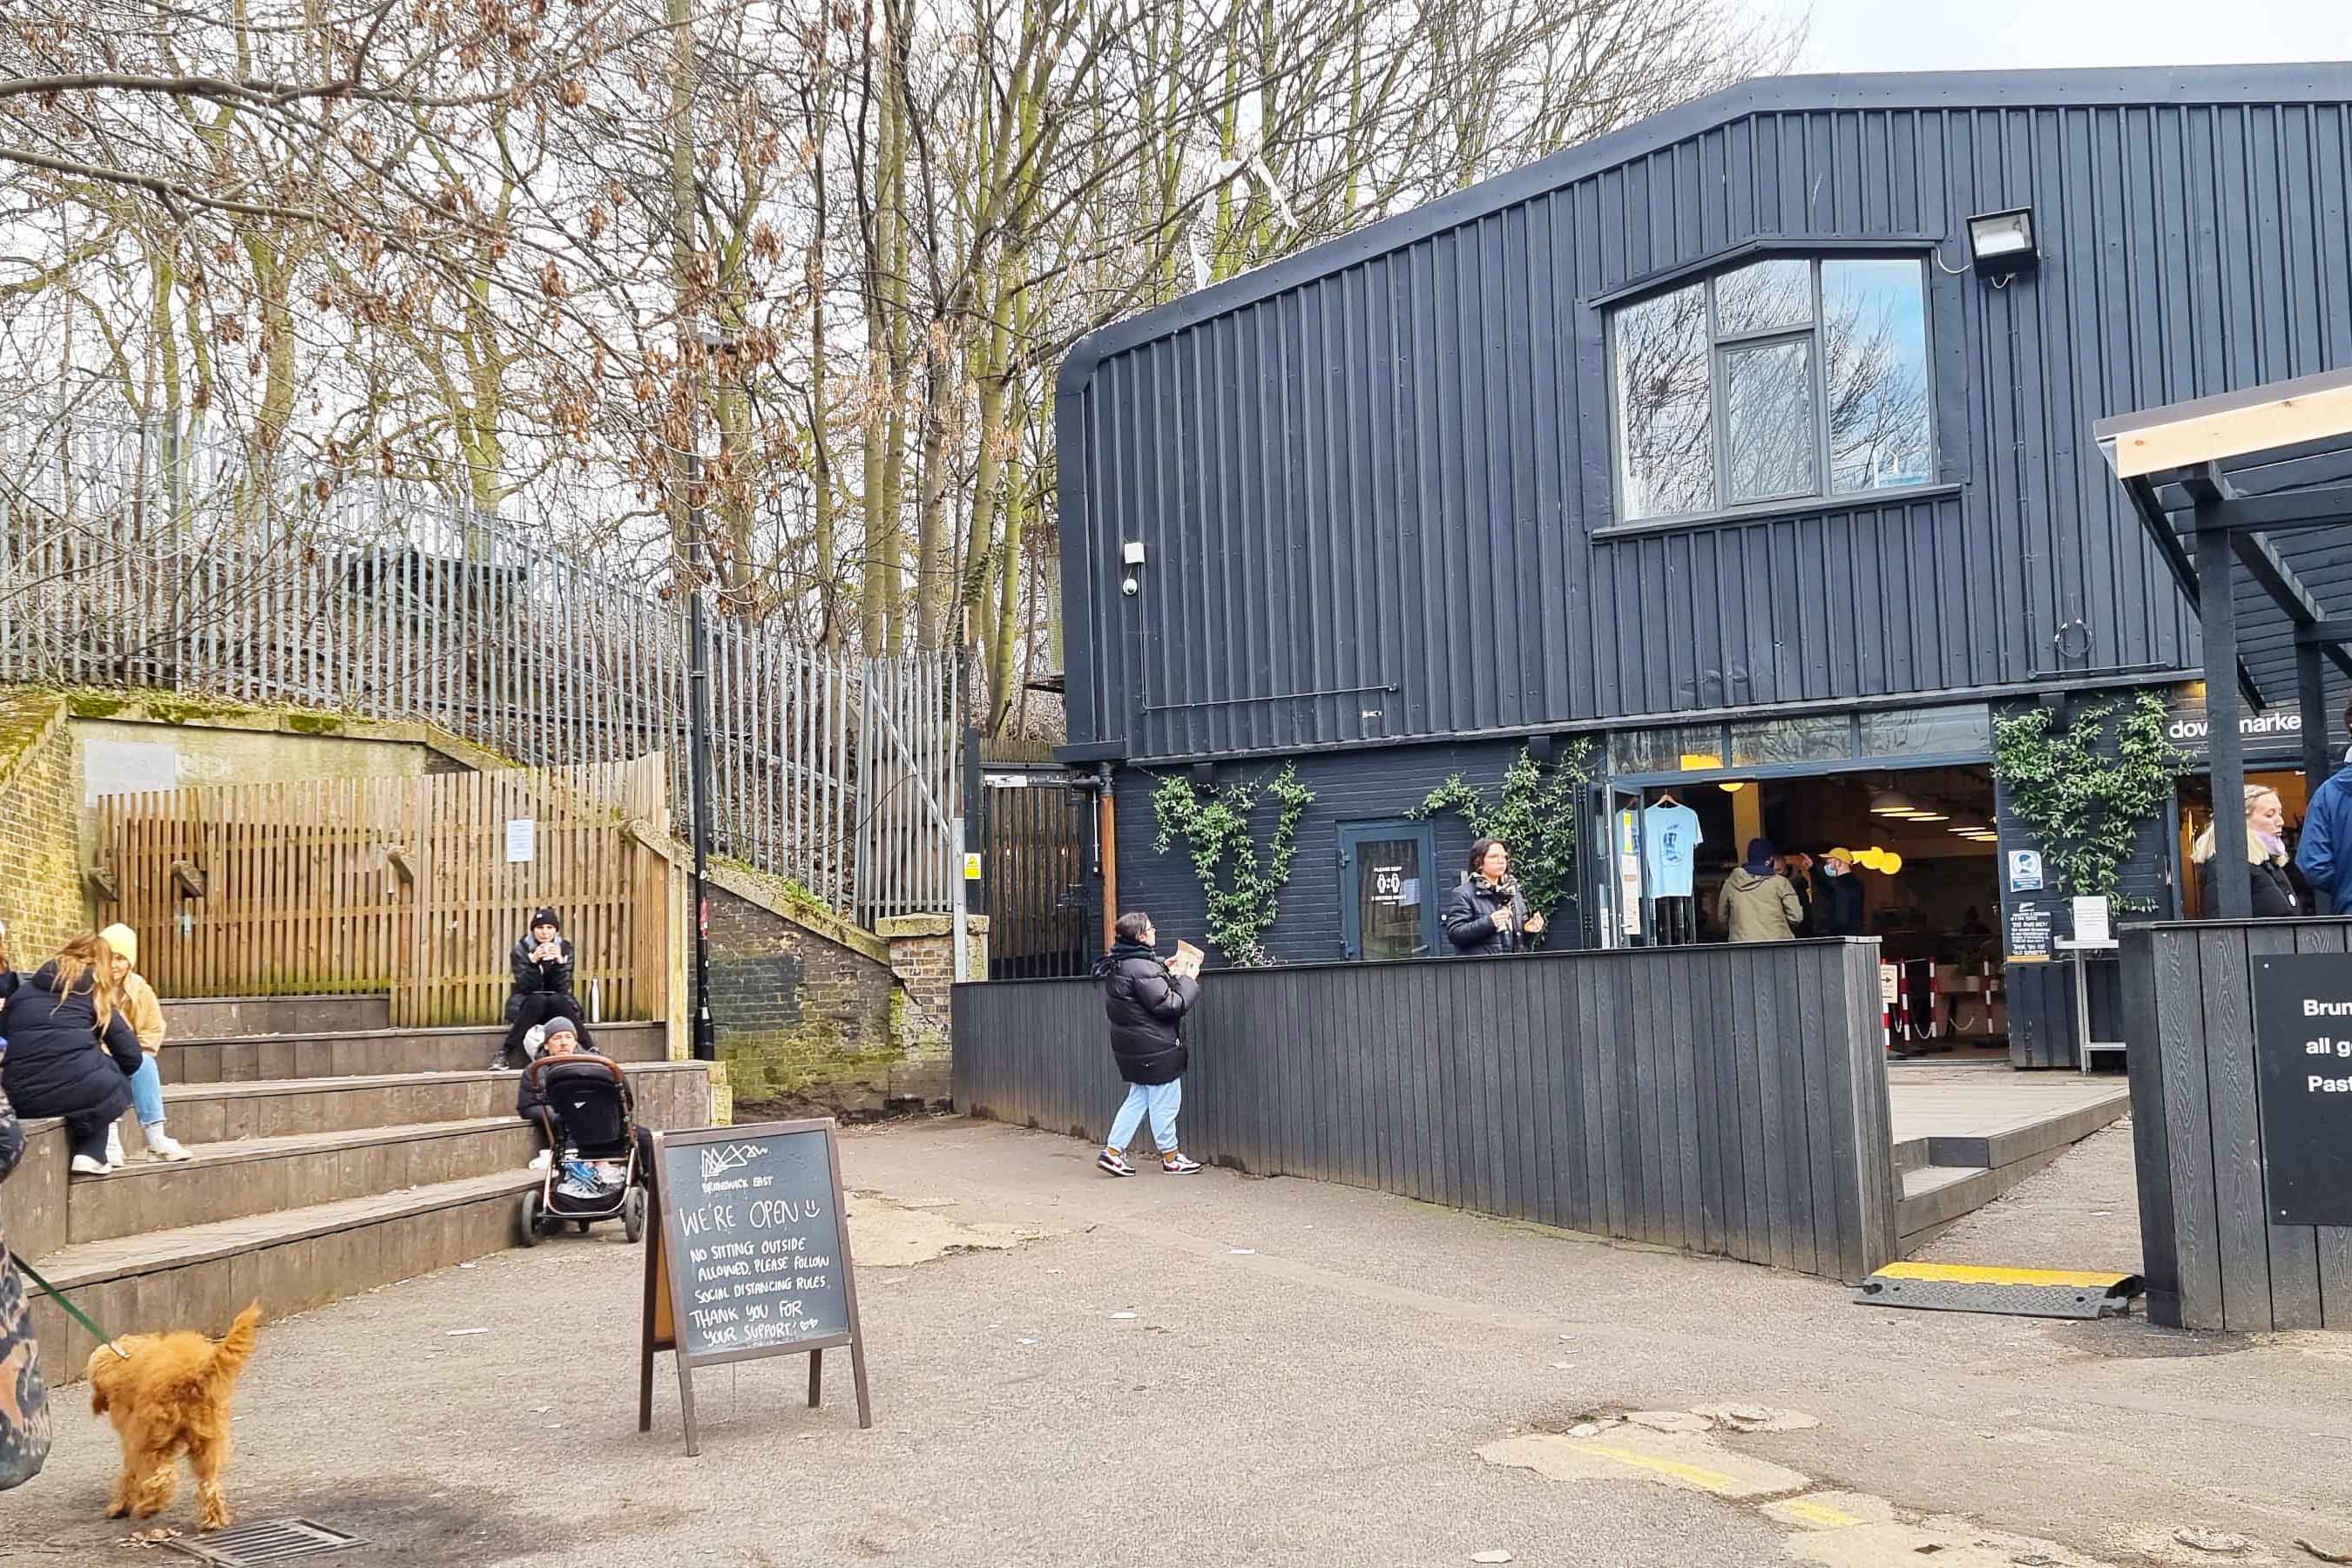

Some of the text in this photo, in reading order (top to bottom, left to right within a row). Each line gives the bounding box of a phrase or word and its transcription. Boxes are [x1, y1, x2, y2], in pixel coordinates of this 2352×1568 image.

[2306, 1037, 2352, 1058] all g
[679, 1200, 799, 1237] WE'RE OPEN
[689, 1237, 807, 1263] NO SITTING OUTSIDE
[698, 1254, 829, 1282] ALLOWED, PLEASE FOLLOW
[694, 1287, 730, 1304] SOCIAL
[733, 1277, 792, 1298] DISTANCING
[689, 1300, 803, 1329] THANK YOU FOR
[702, 1327, 738, 1347] YOUR
